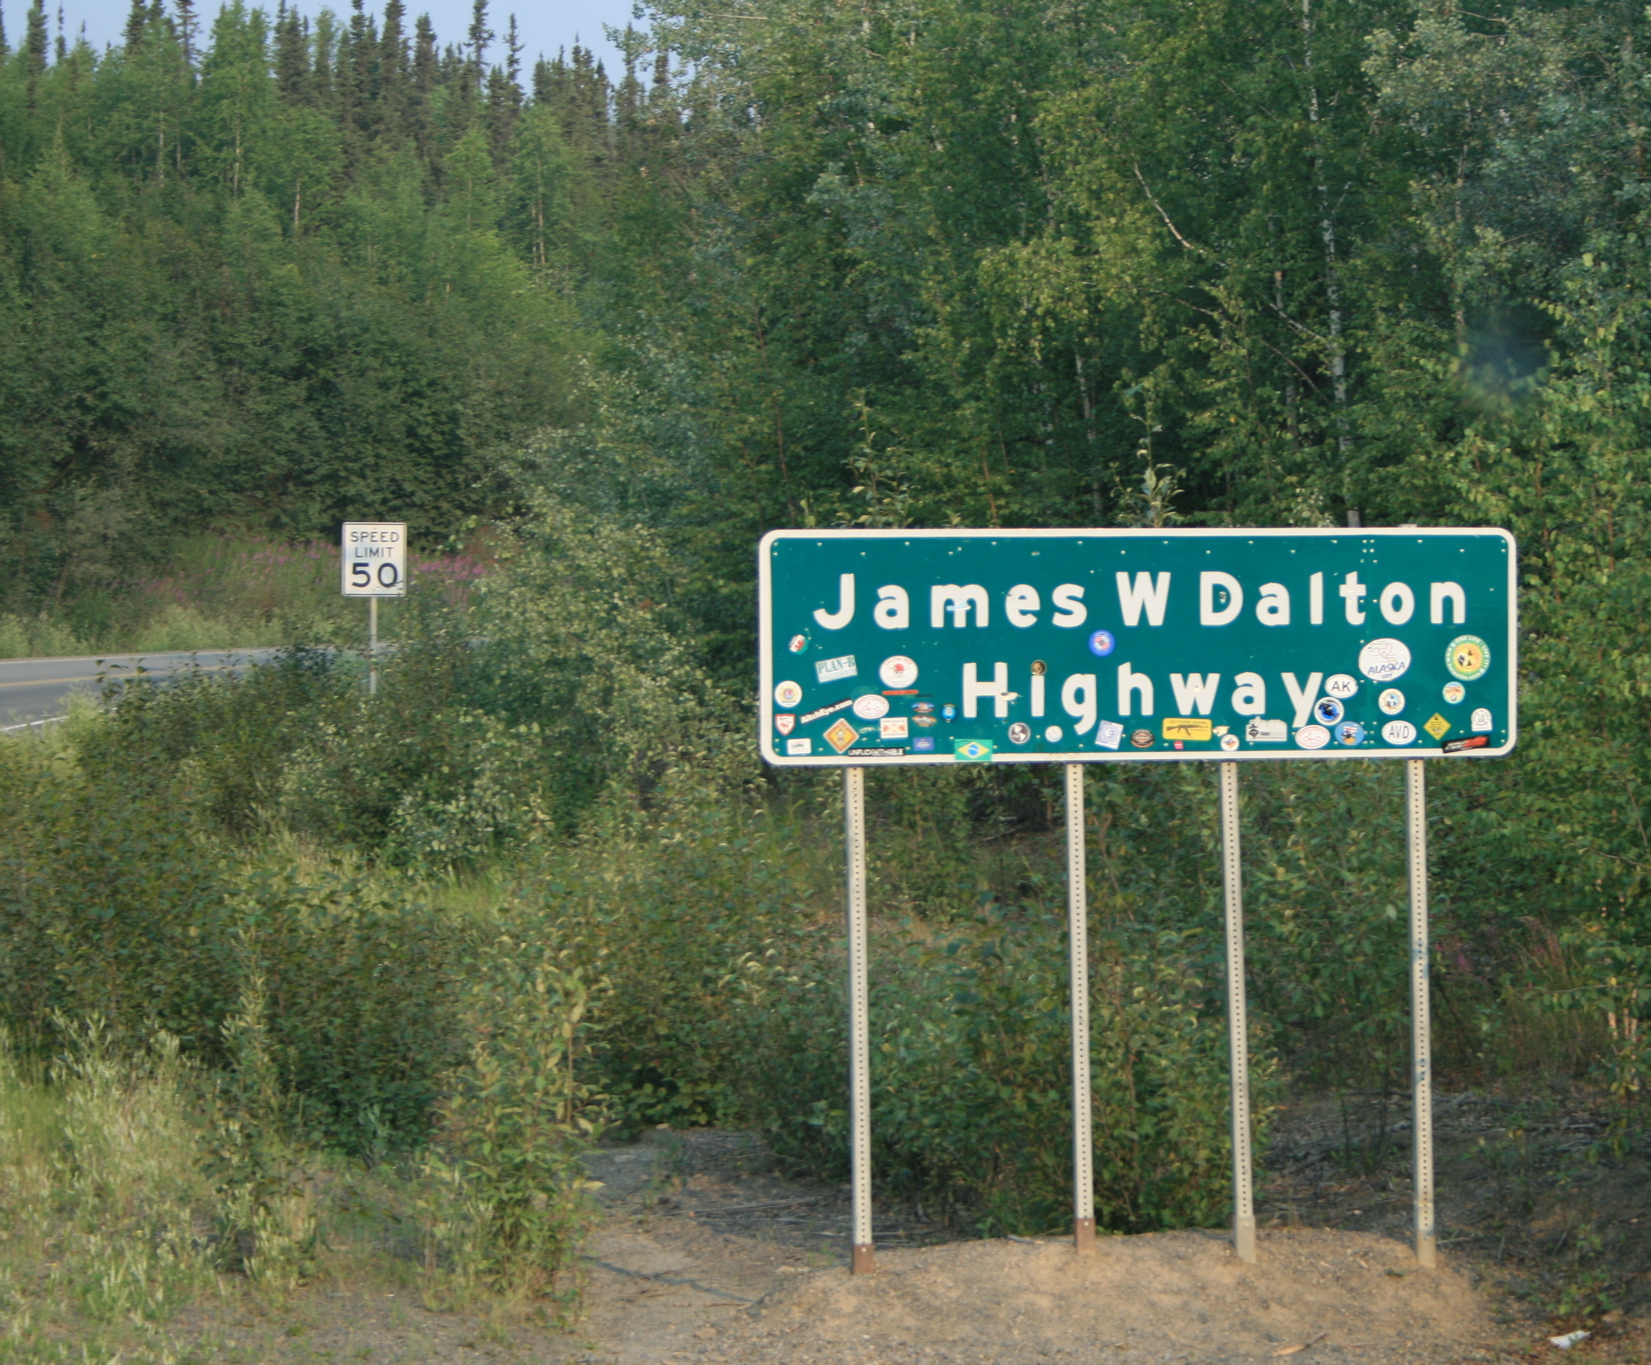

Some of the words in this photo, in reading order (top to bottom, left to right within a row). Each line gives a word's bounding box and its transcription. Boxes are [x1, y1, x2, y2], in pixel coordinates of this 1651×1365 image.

[351, 531, 400, 542] SPEED
[355, 547, 394, 558] LIMIT
[351, 562, 398, 588] 50
[813, 573, 1087, 629] James
[1116, 571, 1171, 626] W
[1200, 571, 1466, 626] Dalton
[1368, 661, 1406, 675] ALASKA
[1331, 681, 1351, 692] AK
[963, 661, 1323, 735] Highway
[1389, 725, 1410, 739] AVD
